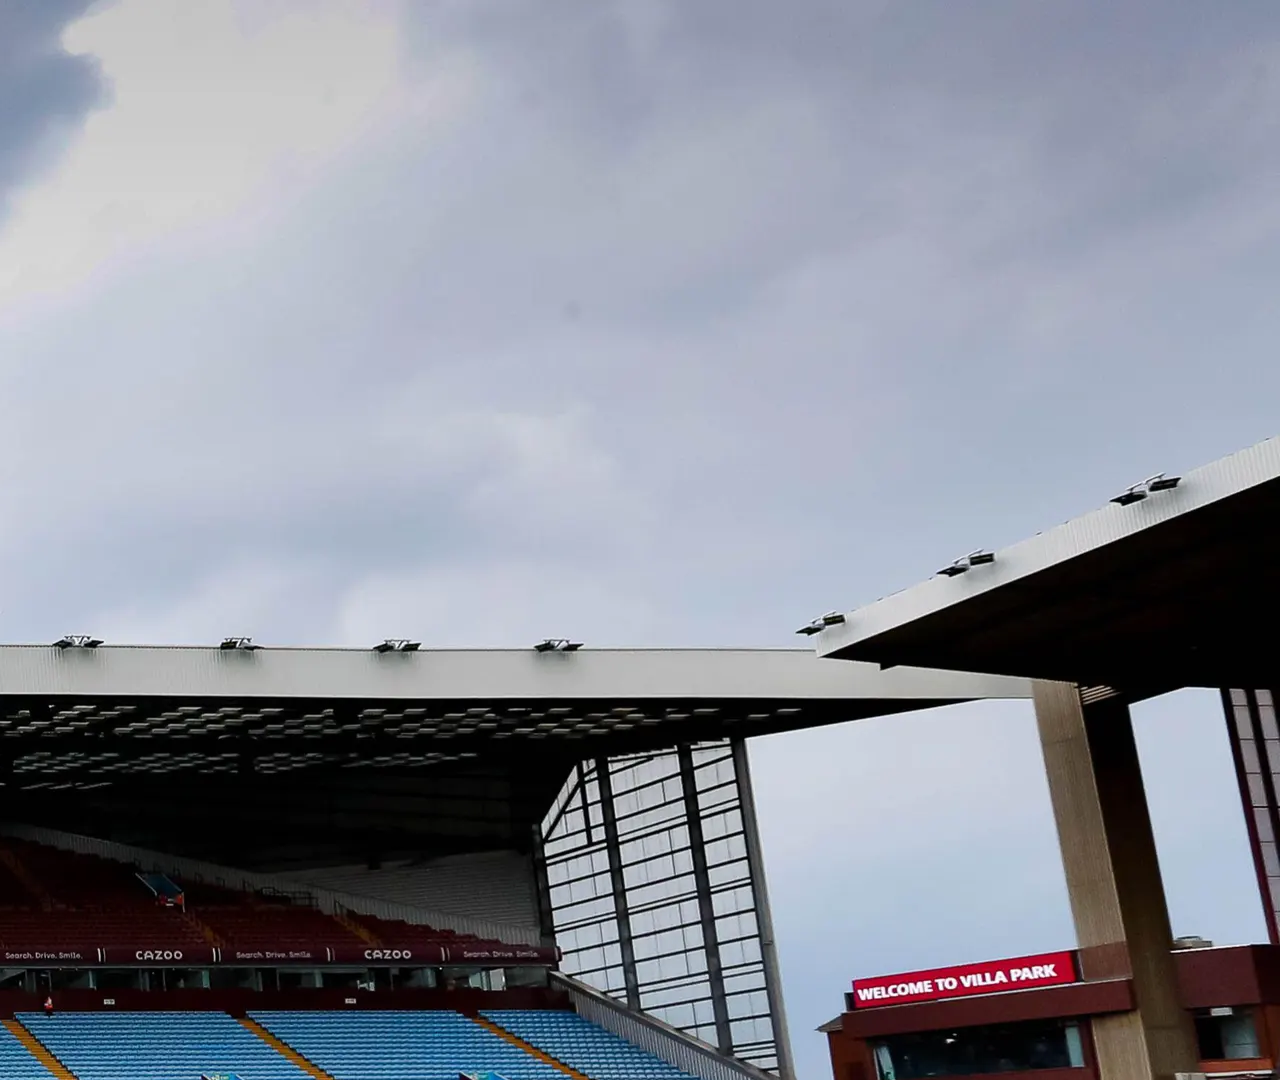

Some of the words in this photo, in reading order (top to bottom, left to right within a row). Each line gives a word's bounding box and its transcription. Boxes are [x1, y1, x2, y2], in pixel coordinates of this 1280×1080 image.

[135, 950, 183, 960] CAZOO
[364, 949, 411, 959] CAZOO
[857, 981, 933, 1001] WELCOME
[934, 977, 958, 991] TO
[959, 970, 1008, 988] VILLA
[1010, 964, 1058, 982] PARK
